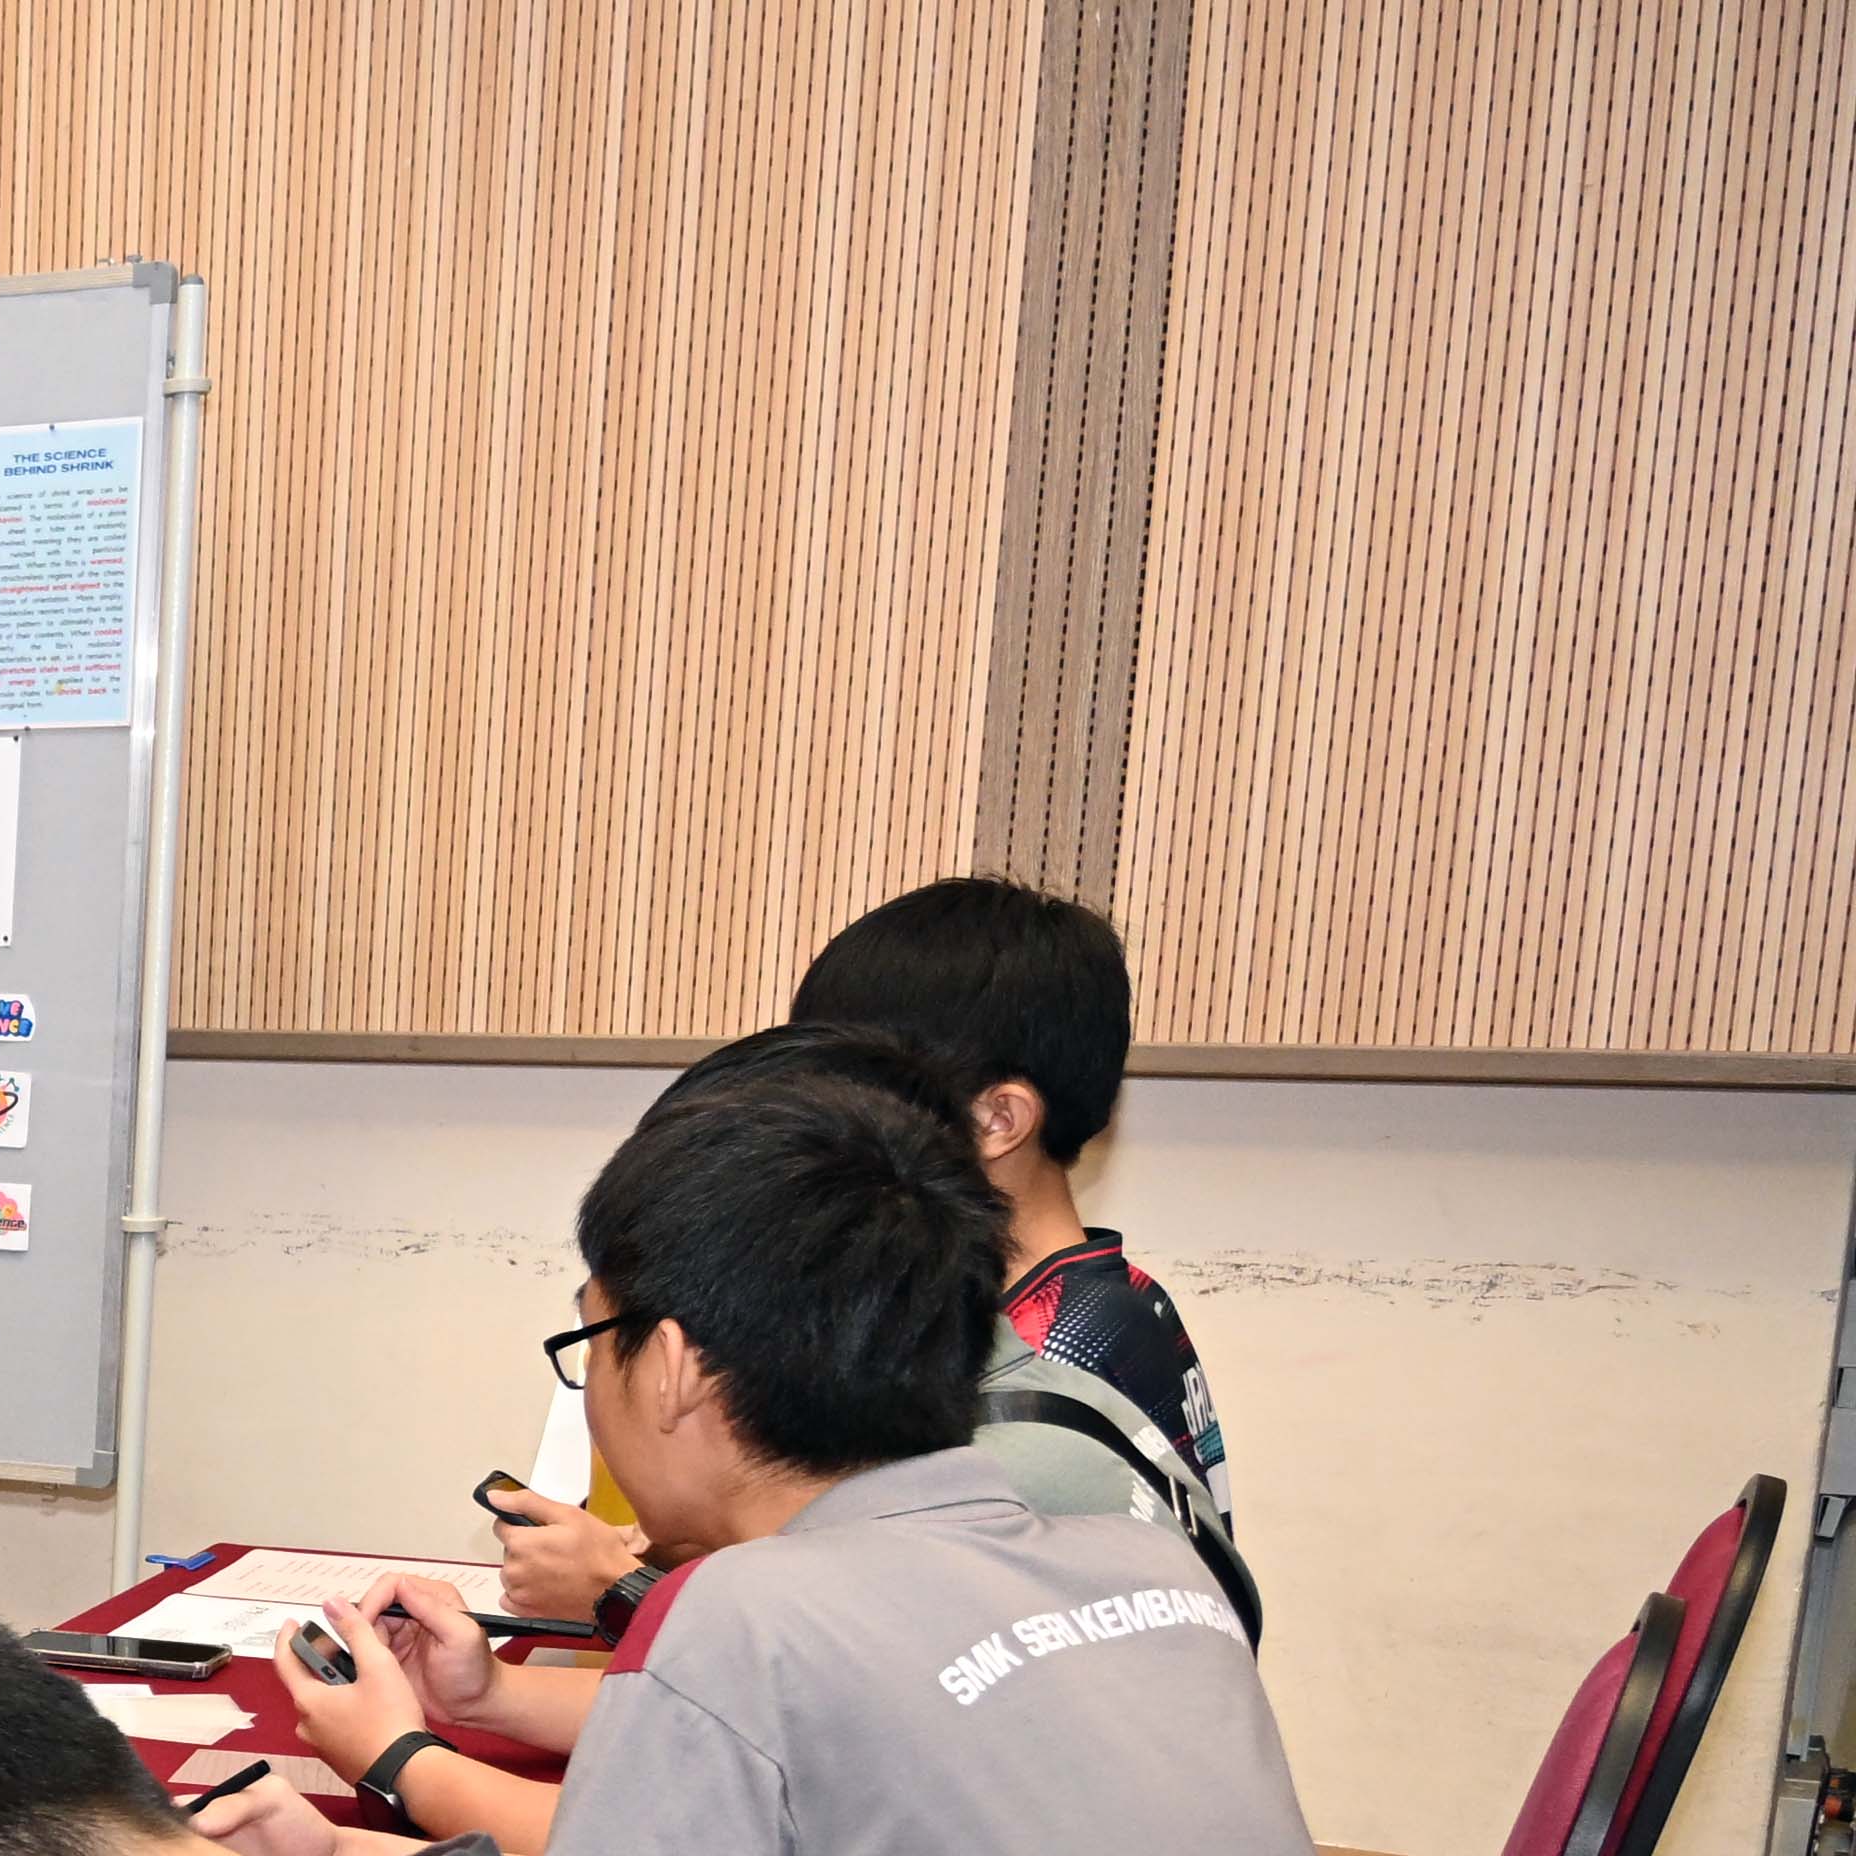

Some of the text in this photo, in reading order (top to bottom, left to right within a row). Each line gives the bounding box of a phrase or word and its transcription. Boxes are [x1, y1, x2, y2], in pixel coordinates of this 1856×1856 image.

[13, 448, 106, 463] THE SCIENCE
[3, 460, 114, 476] BEHIND SHRINK
[938, 1633, 1023, 1705] SMK
[1014, 1612, 1081, 1657] SERI
